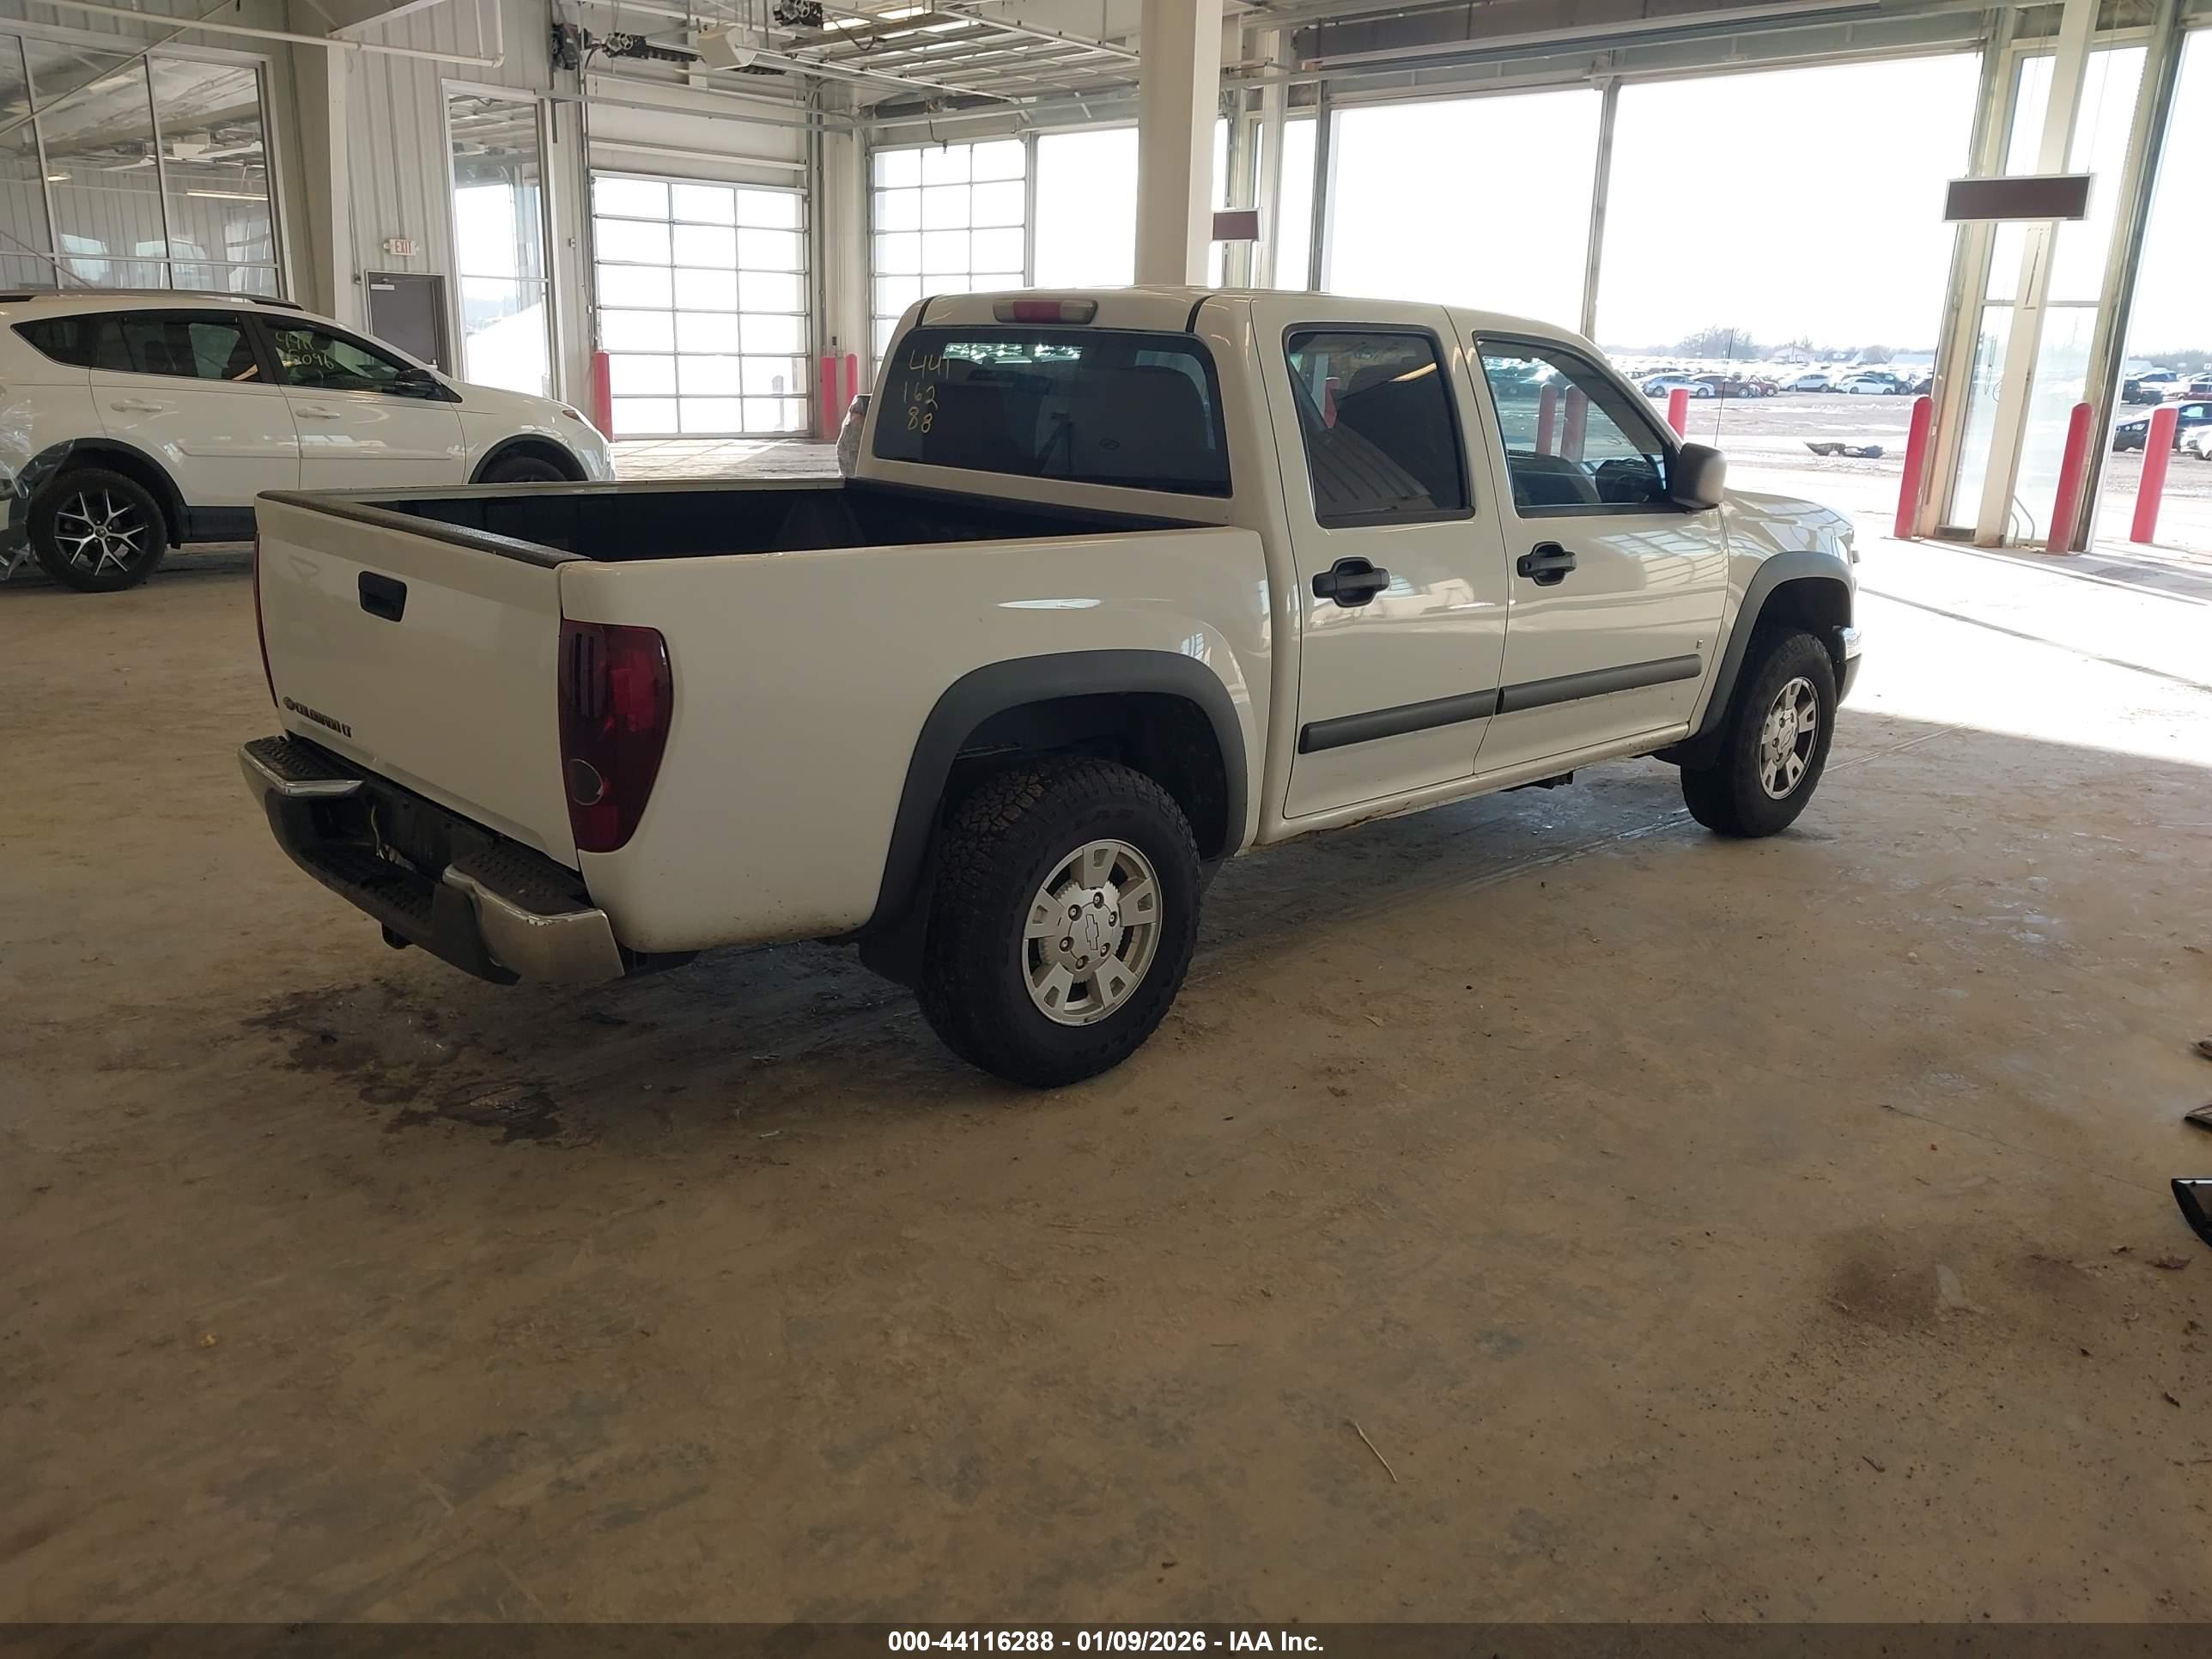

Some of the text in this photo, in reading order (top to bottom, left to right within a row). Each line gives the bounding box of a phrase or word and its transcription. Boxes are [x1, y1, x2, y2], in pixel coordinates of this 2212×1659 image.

[395, 240, 411, 254] EXIT
[909, 349, 950, 380] 441
[903, 381, 939, 410] 162
[908, 406, 933, 433] 88
